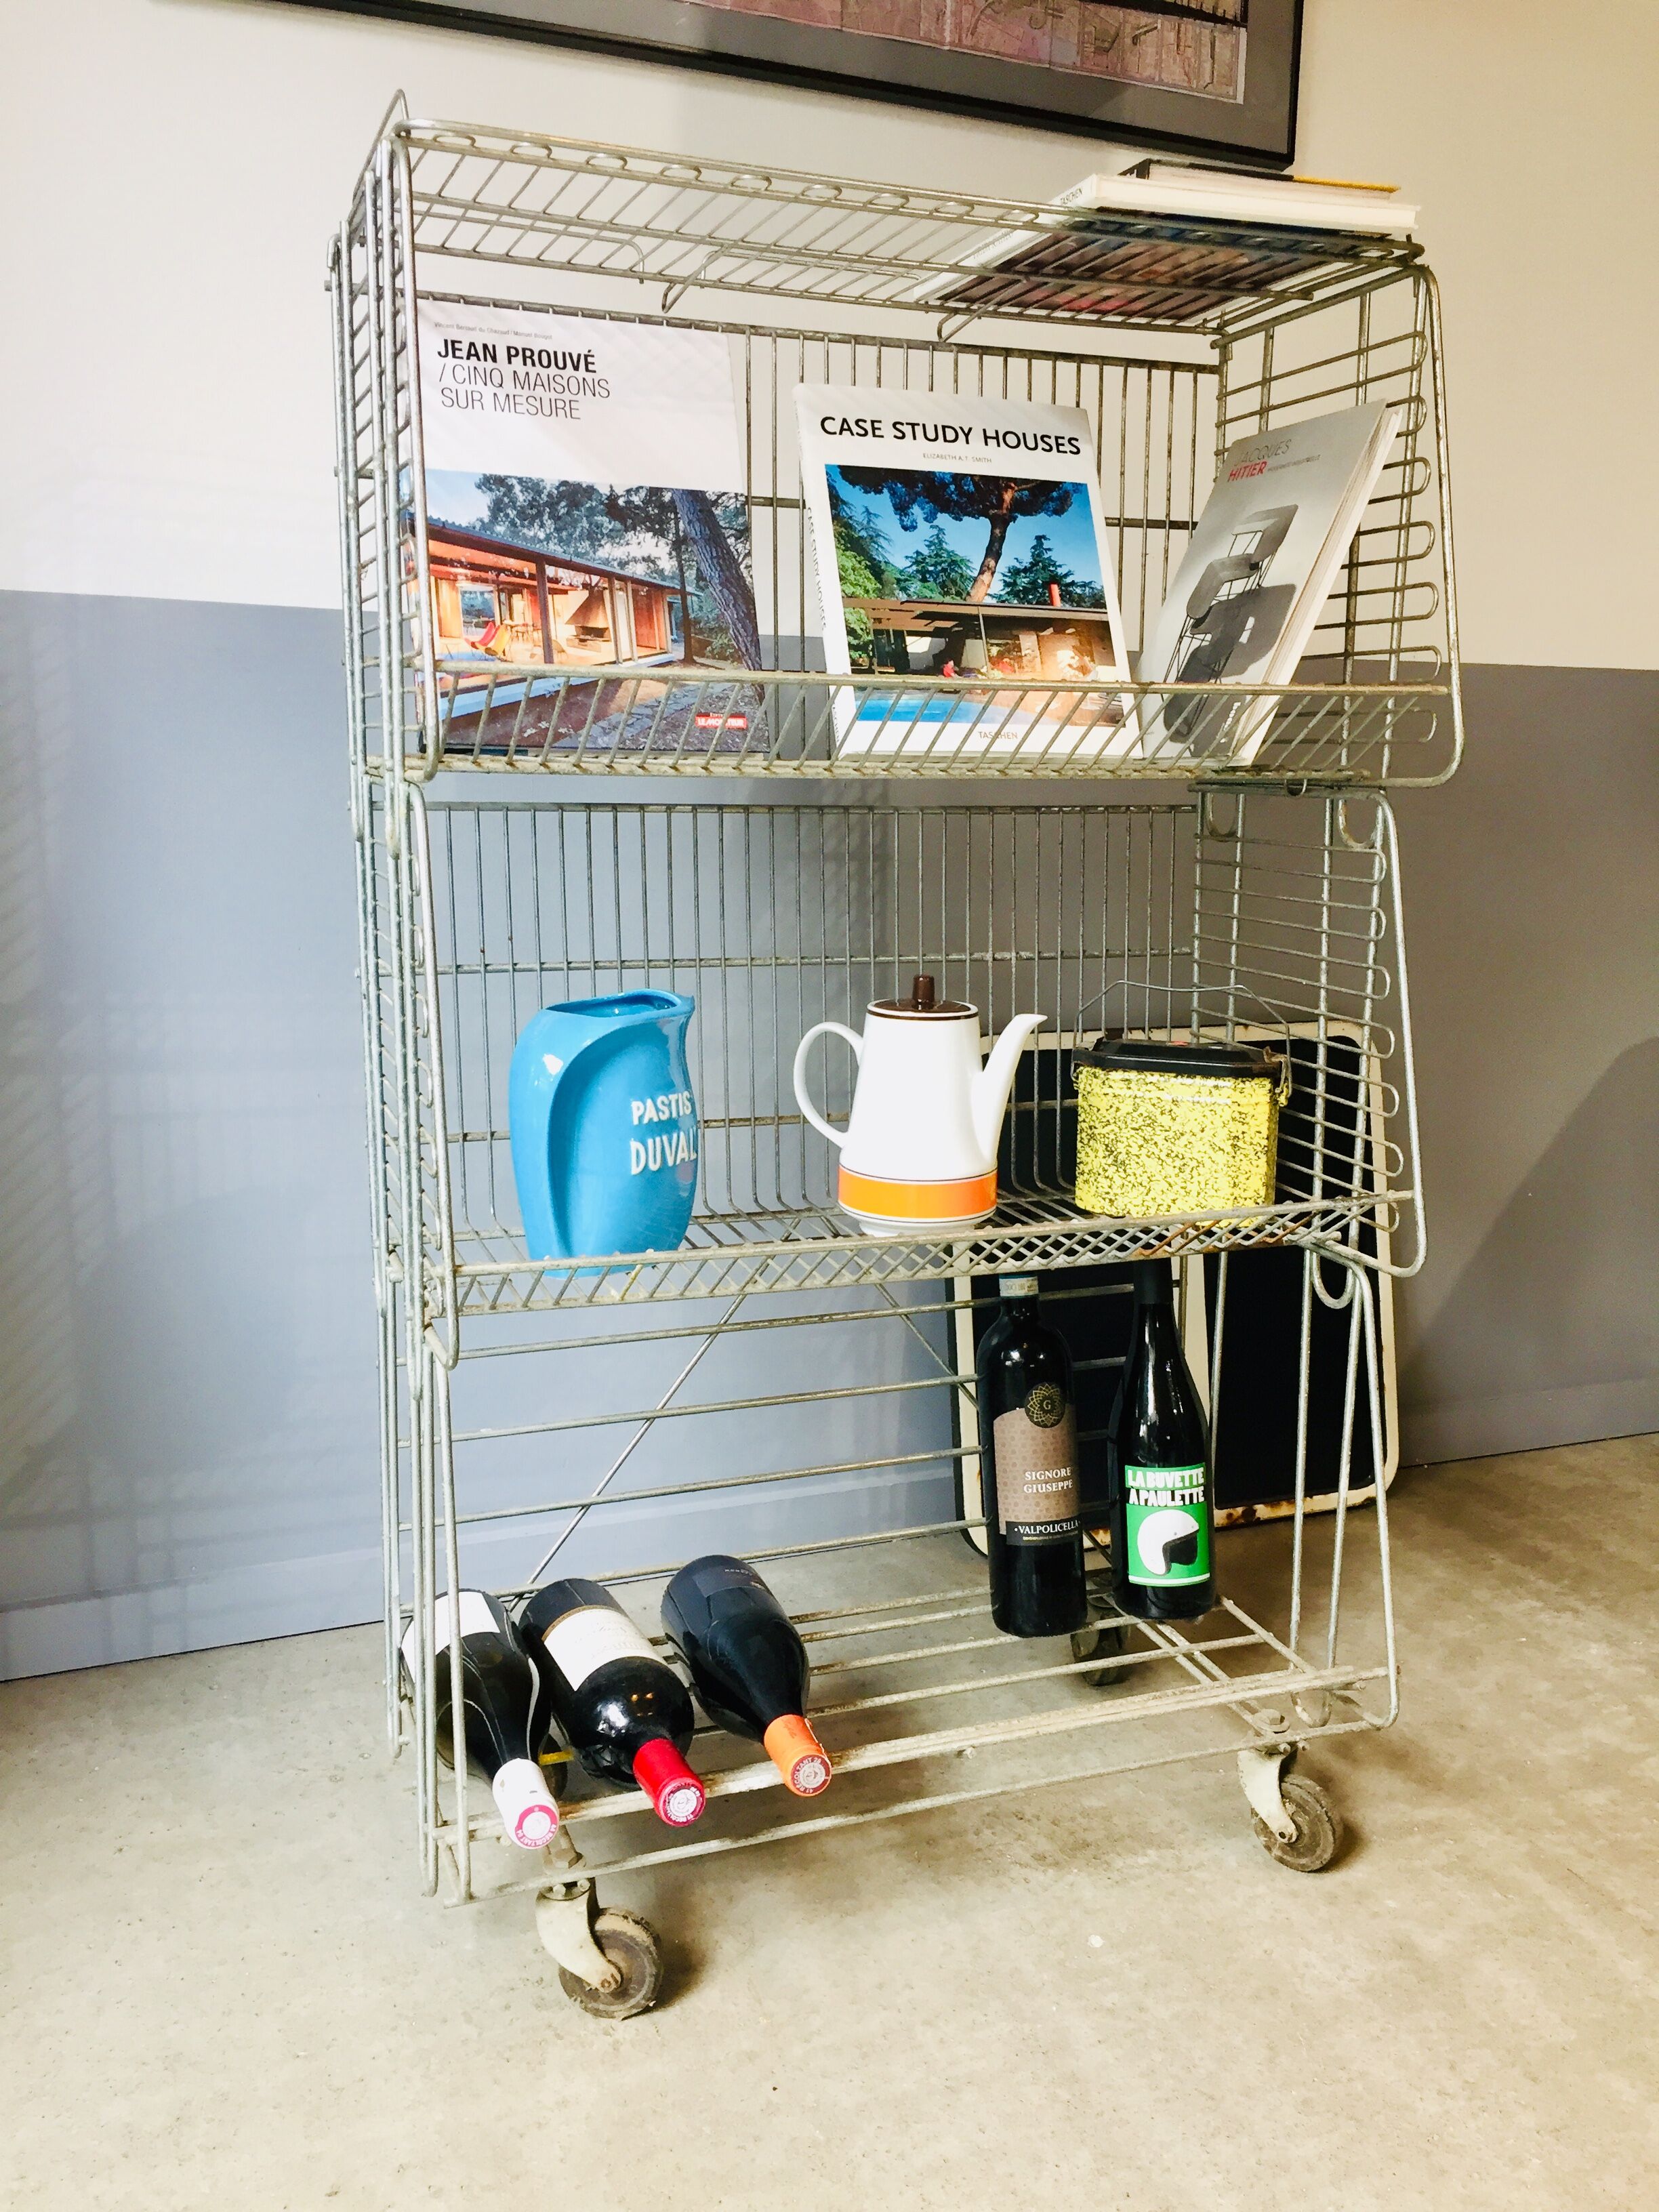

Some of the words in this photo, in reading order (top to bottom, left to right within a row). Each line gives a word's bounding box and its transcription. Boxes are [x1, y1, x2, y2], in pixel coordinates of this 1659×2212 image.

[437, 338, 497, 364] JEAN
[506, 344, 597, 373] PROUVÉ
[513, 373, 610, 399] MAISONS
[441, 387, 485, 411] SUR
[493, 392, 581, 420] MESURE
[820, 415, 884, 438] CASE
[892, 421, 973, 445] STUDY
[982, 428, 1082, 456] HOUSES
[923, 453, 957, 461] ELIZABETH
[1234, 438, 1292, 466] JACQUES
[1227, 460, 1268, 482] HITIER
[978, 731, 1018, 739] TASHEN
[631, 1090, 692, 1126] PASTIS
[630, 1128, 697, 1175] DUVAL
[1044, 1399, 1051, 1410] G
[1025, 1467, 1071, 1481] SIGNORE
[1127, 1469, 1146, 1488] LA
[1146, 1467, 1204, 1488] BUVETTE
[1023, 1479, 1073, 1494] GIUSEPPE
[1139, 1485, 1205, 1507] PAULETTE
